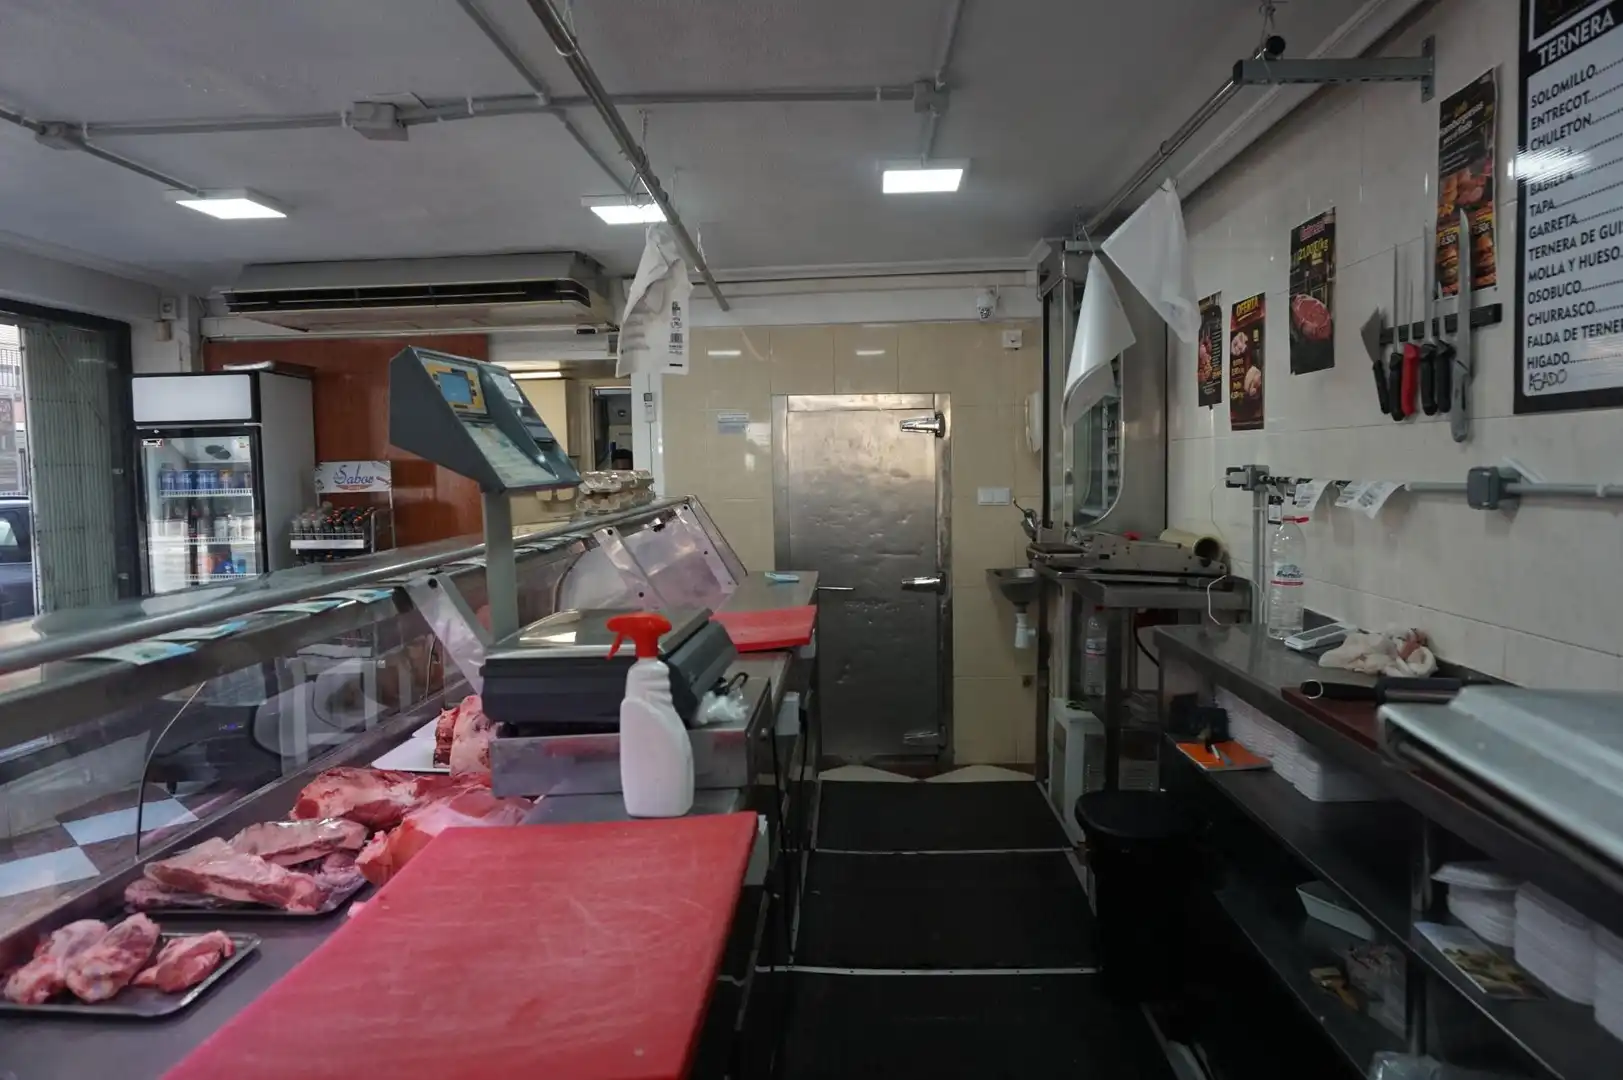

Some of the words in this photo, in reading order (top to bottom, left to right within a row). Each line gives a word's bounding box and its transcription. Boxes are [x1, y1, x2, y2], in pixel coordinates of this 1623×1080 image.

[1537, 8, 1615, 67] TERNERA
[1531, 64, 1596, 109] SOLOMILLO
[1531, 90, 1590, 130] ENTRECOT
[1529, 198, 1556, 217] TAPA
[1528, 237, 1577, 261] TERNERA
[1580, 229, 1597, 246] DE
[1599, 219, 1623, 240] GUI
[1529, 213, 1578, 239] GARRETA
[1528, 262, 1566, 282] MOLLA
[1568, 258, 1576, 271] Y
[1579, 246, 1621, 270] HUESO
[1527, 280, 1582, 305] OSOBUCO
[1527, 300, 1596, 327] CHURRASCO
[1527, 332, 1561, 348] FALDA
[1564, 327, 1578, 342] DE
[1580, 318, 1623, 339] TERNE
